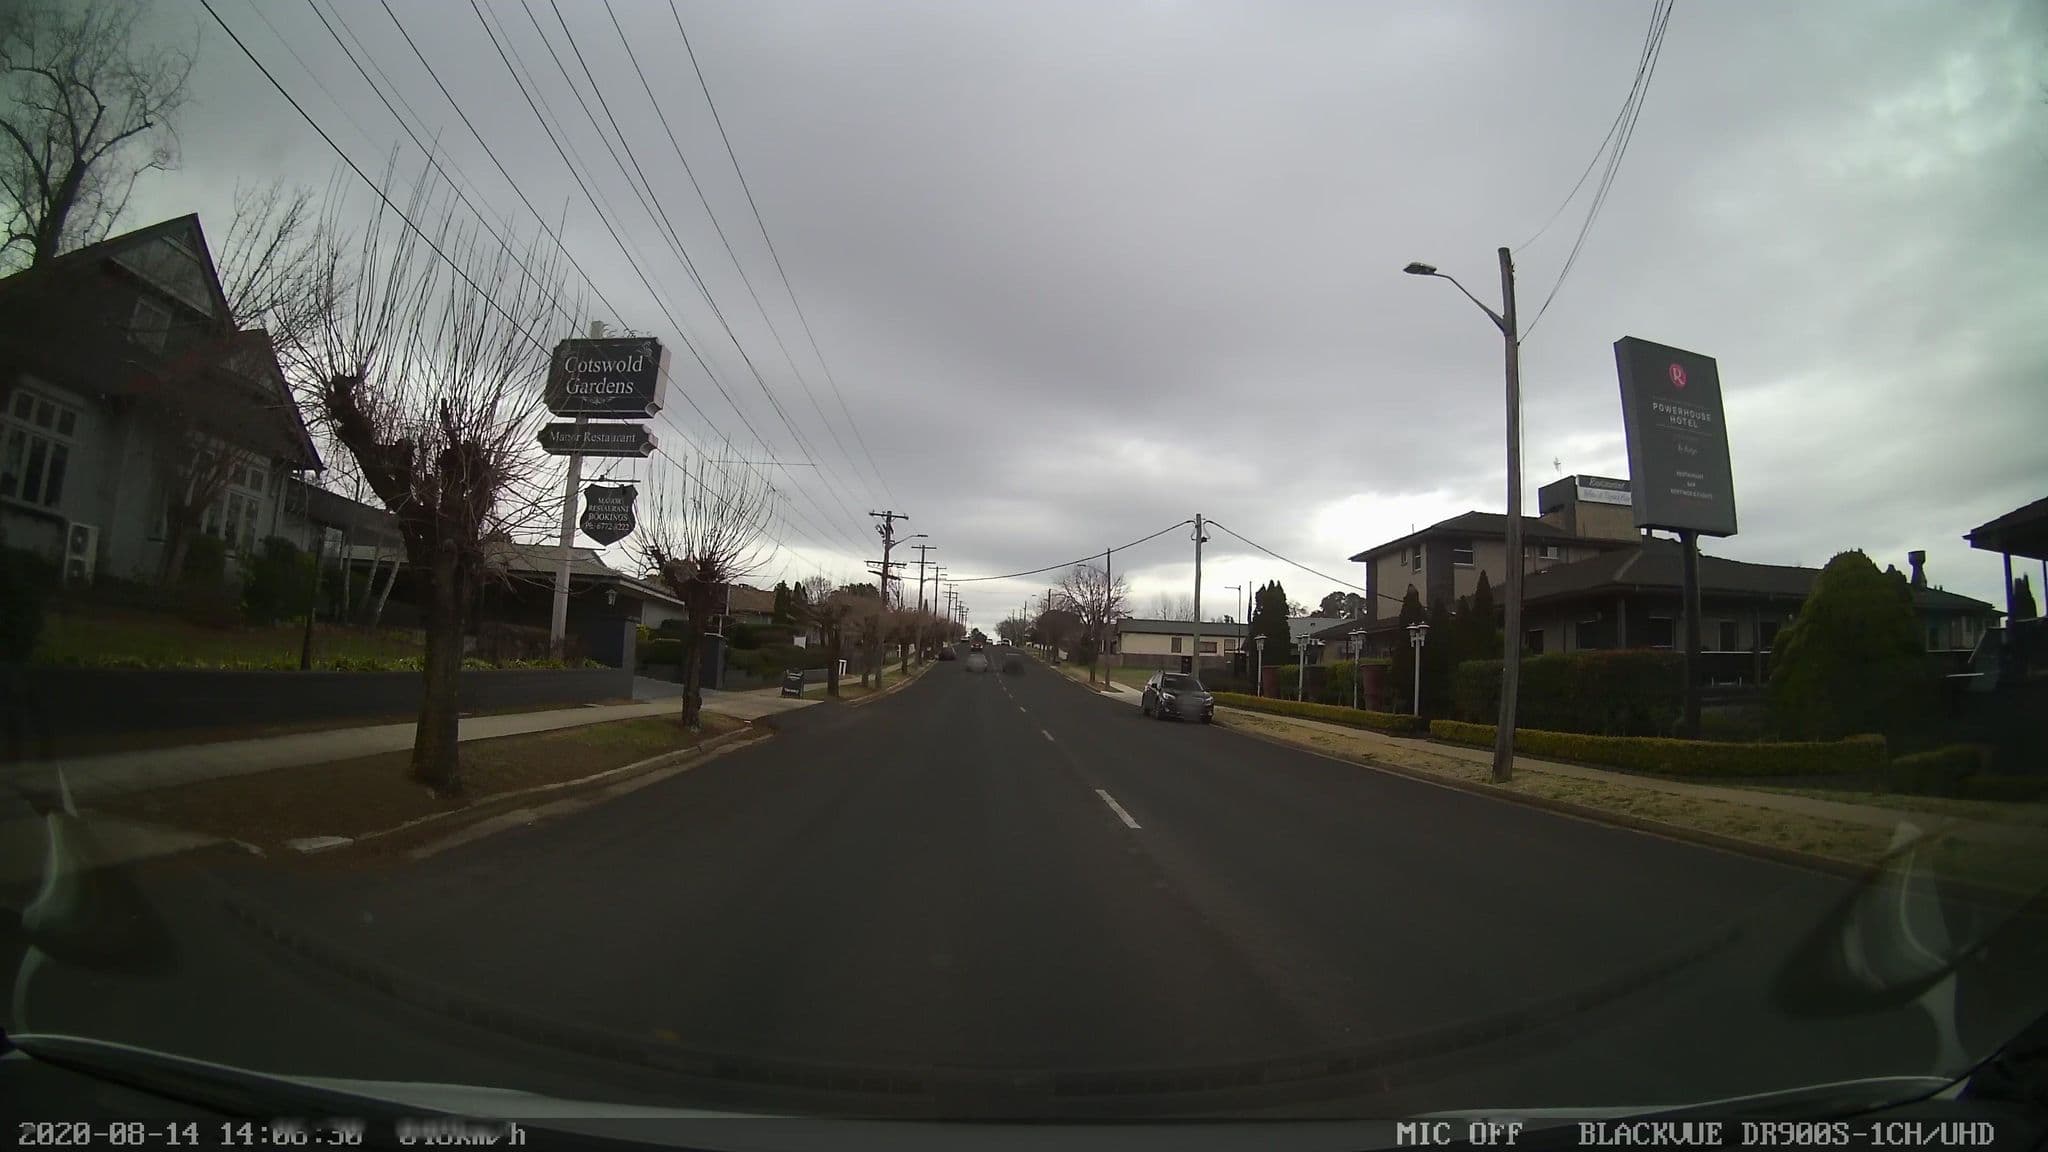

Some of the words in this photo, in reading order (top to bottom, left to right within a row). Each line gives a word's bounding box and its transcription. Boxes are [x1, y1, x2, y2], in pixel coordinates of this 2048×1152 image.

[565, 355, 643, 373] Cotswold
[566, 377, 634, 394] Gardens
[1652, 402, 1711, 421] POWERHOUSE
[1669, 415, 1699, 428] HOTEL
[584, 431, 636, 443] Restaurant
[588, 512, 629, 521] BOOKINGS
